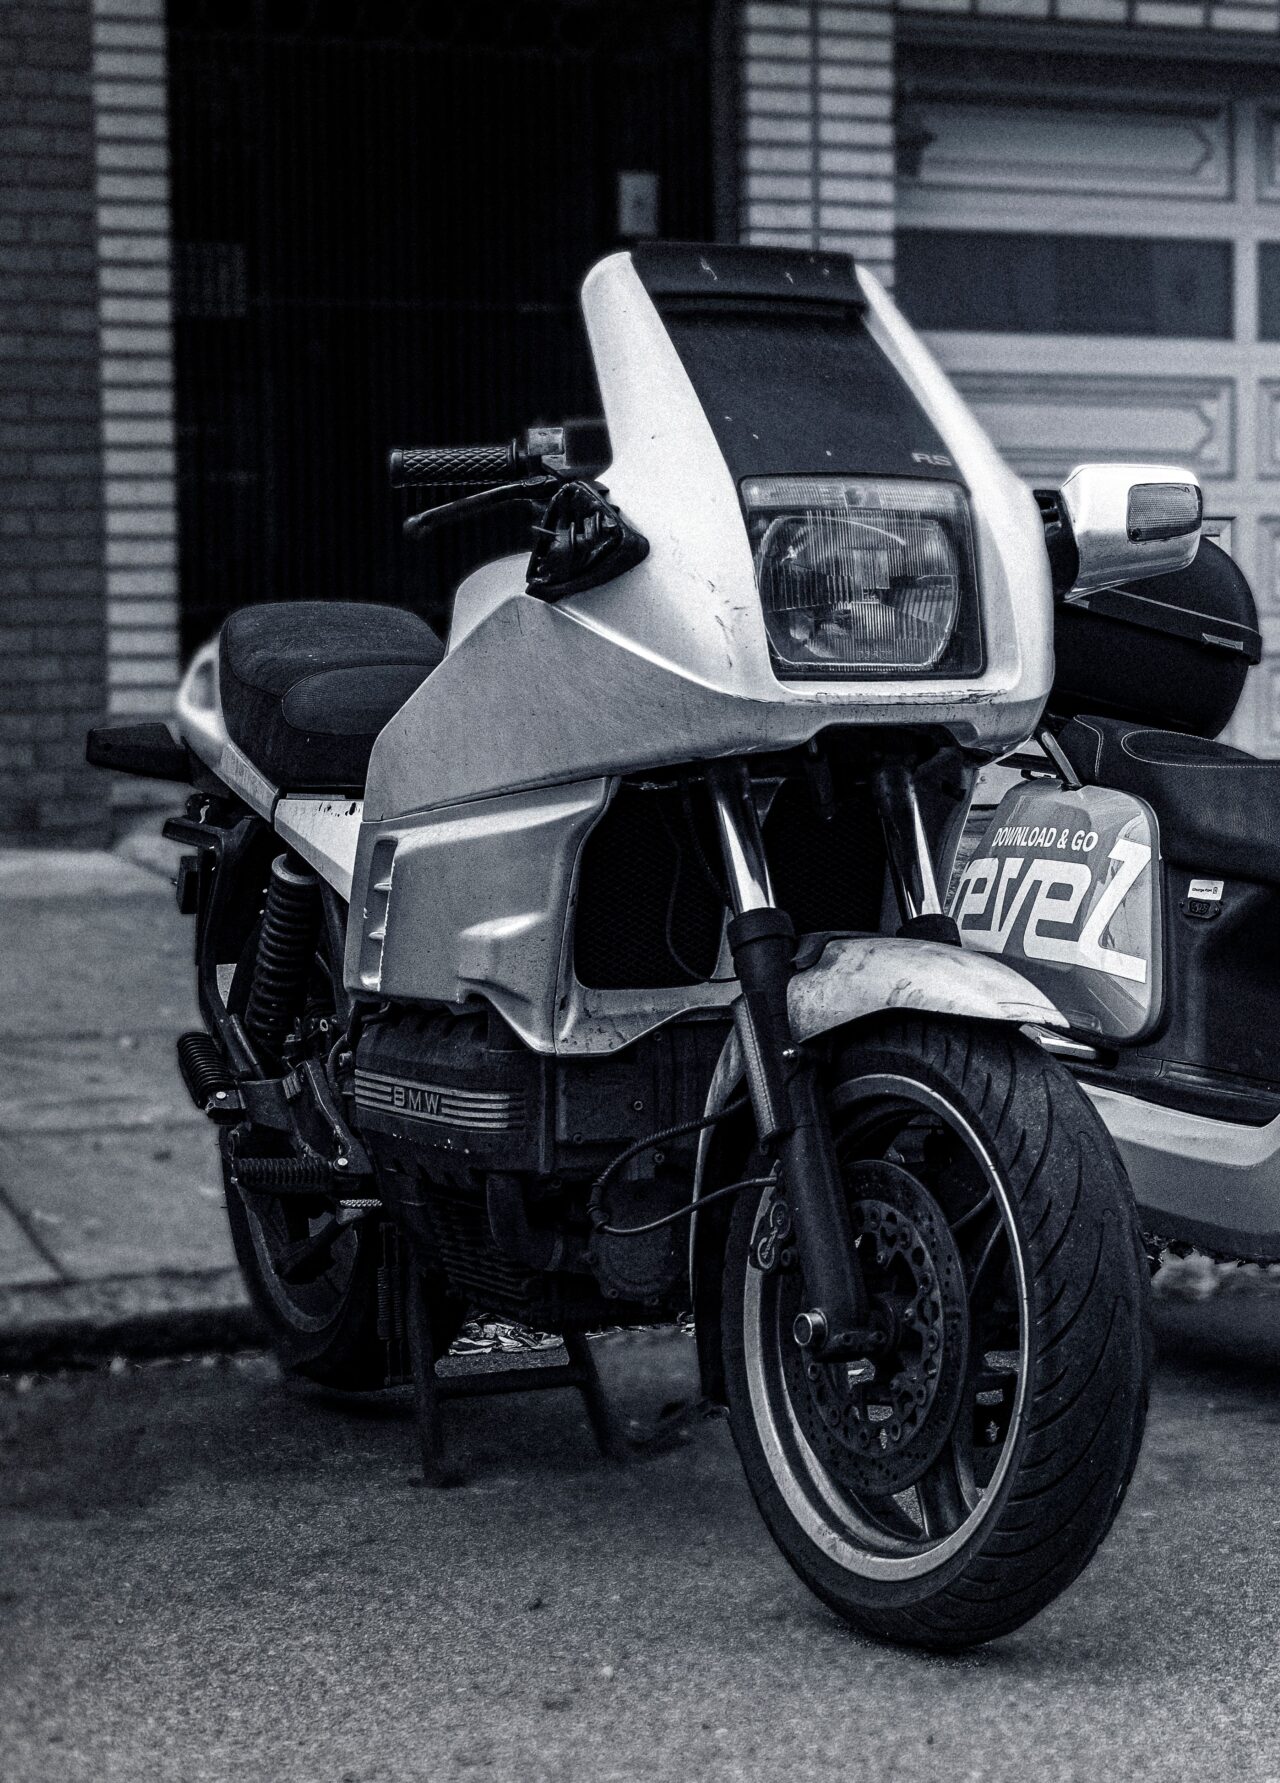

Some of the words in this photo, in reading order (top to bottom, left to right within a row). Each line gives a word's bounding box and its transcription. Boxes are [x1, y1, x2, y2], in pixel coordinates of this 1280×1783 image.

[911, 452, 952, 466] RS
[992, 827, 1056, 848] DOWNLOAD
[1057, 828, 1069, 849] &
[1071, 830, 1098, 851] GO
[394, 1086, 440, 1114] BMW
